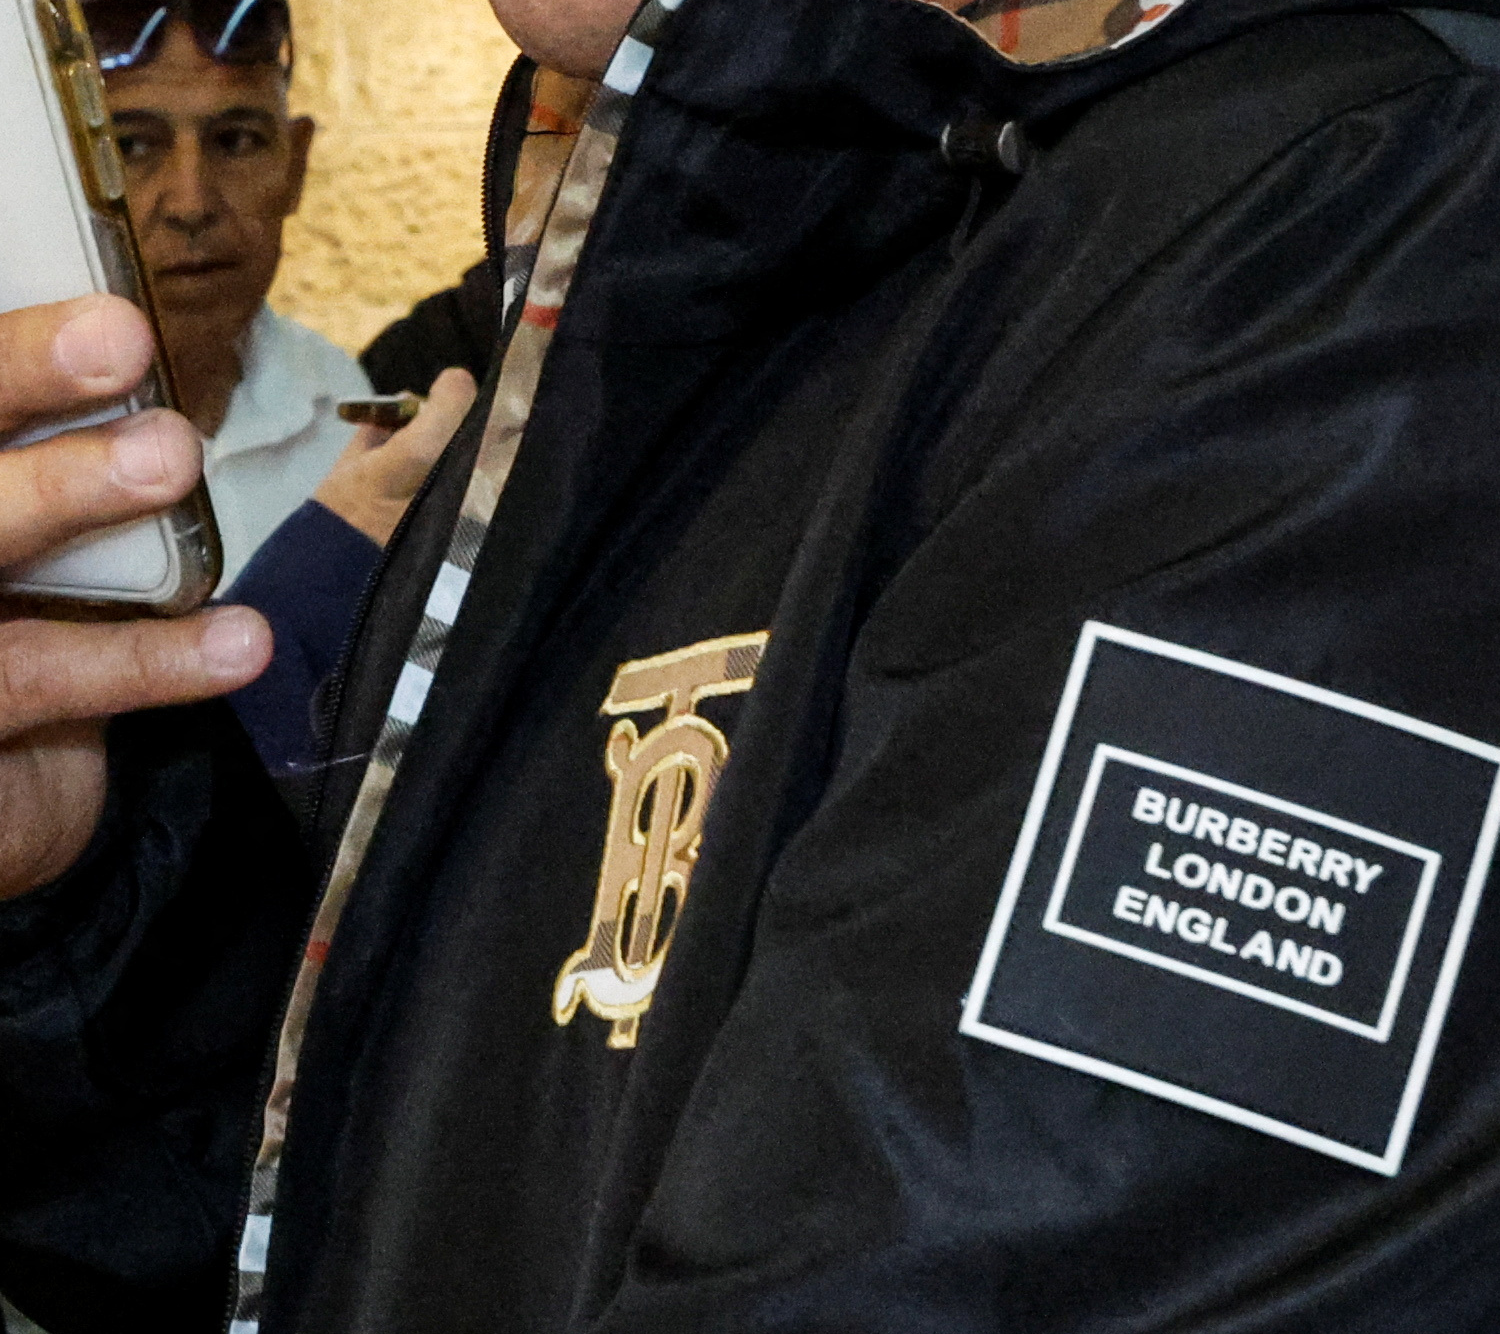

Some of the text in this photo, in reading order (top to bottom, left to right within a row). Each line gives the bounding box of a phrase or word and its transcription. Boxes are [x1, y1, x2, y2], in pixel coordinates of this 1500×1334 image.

[1131, 786, 1384, 895] BURBERRY
[1143, 841, 1347, 935] LONDON
[1112, 884, 1345, 989] ENGLAND
